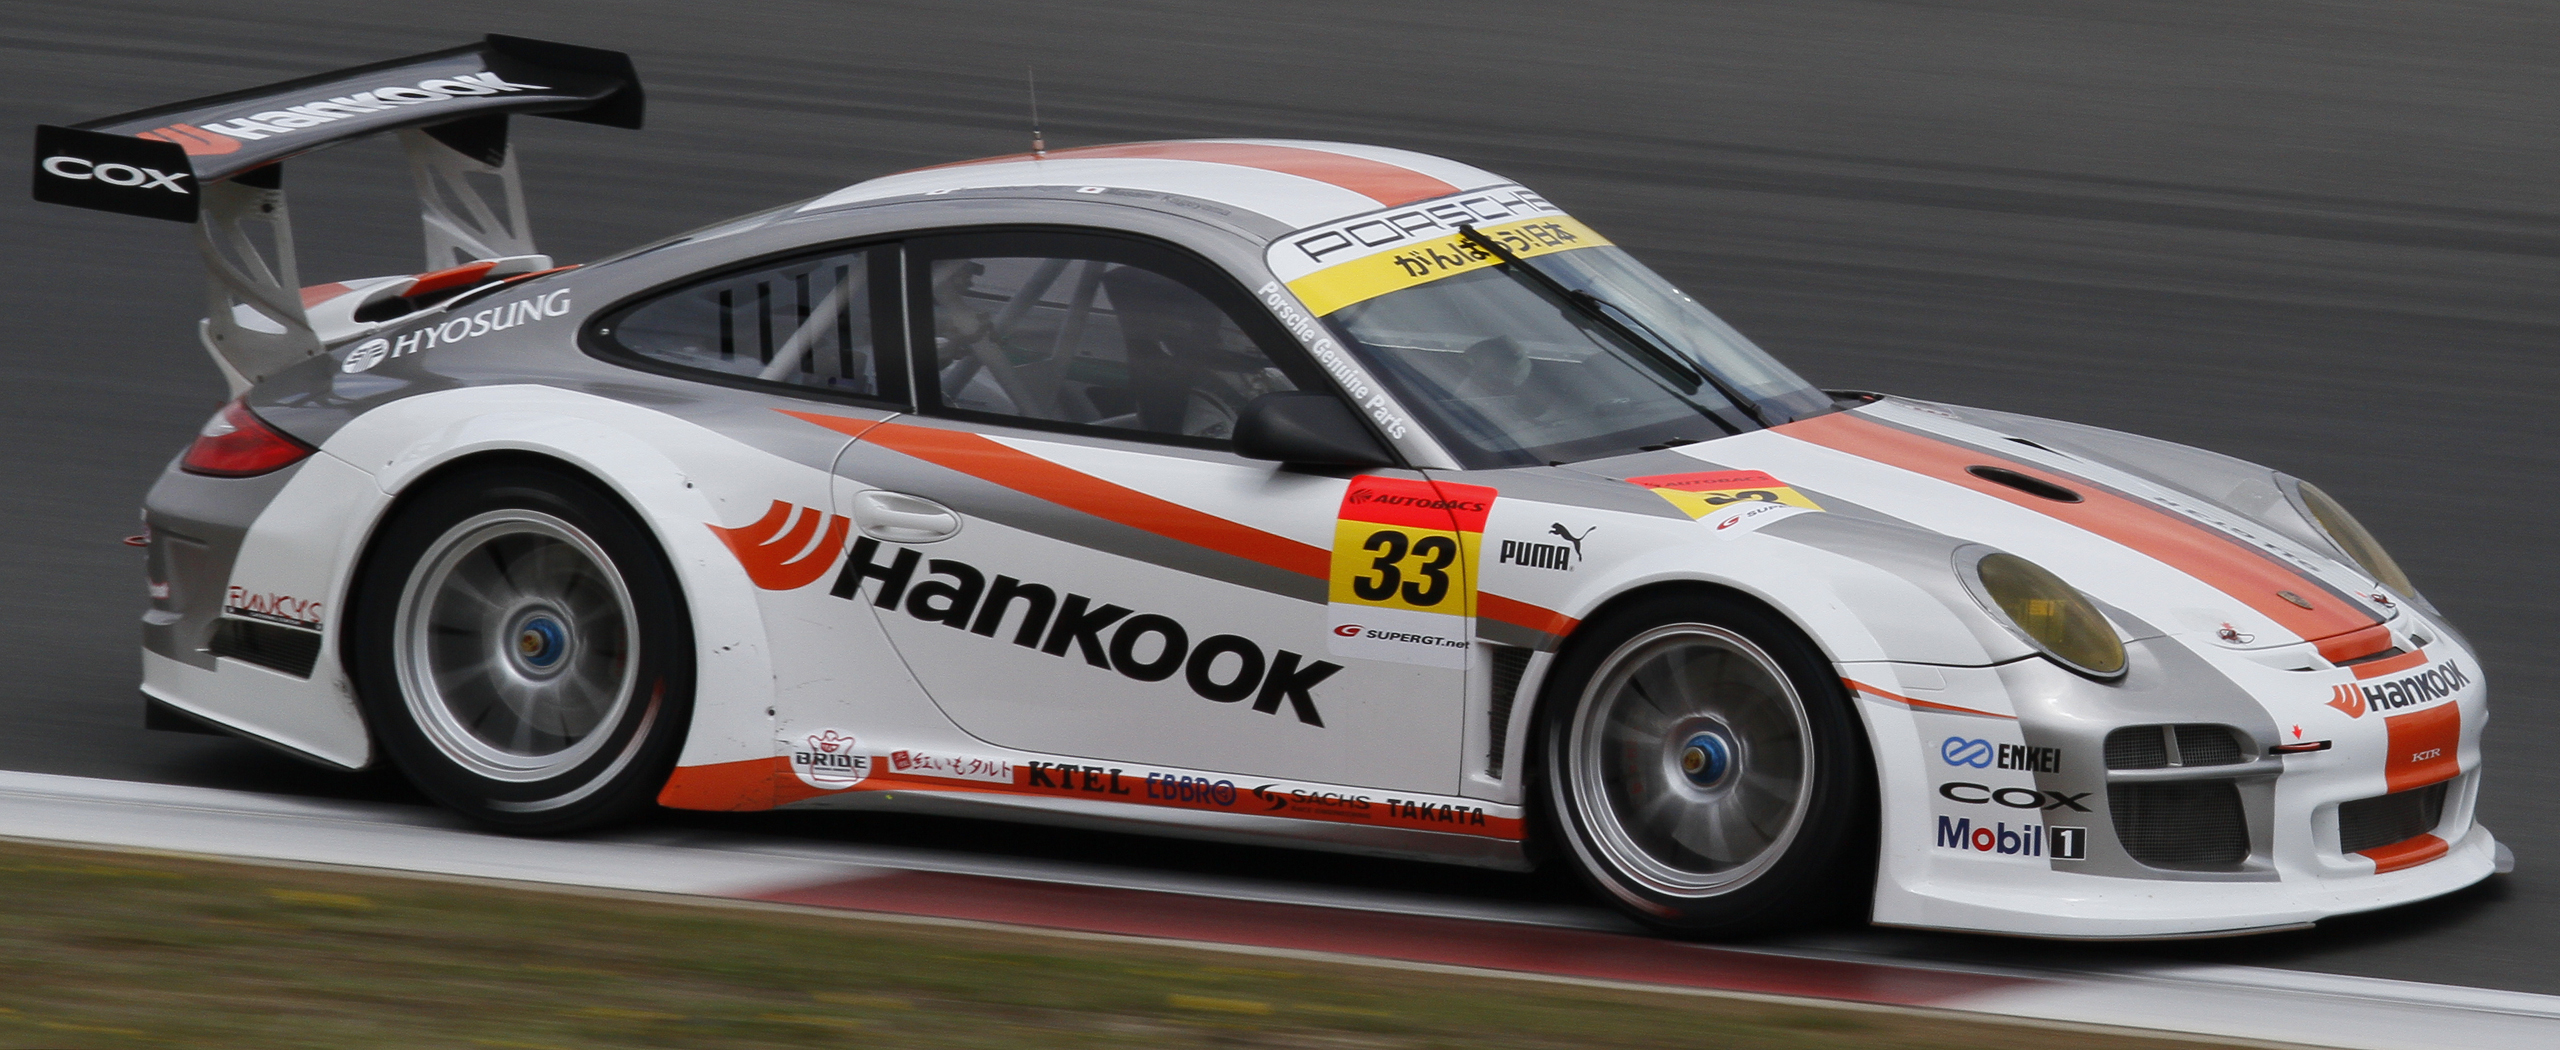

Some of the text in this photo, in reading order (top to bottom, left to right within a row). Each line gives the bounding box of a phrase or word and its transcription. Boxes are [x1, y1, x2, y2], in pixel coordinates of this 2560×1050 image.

[42, 156, 190, 194] COX
[1293, 189, 1560, 263] PORSCHE
[390, 288, 571, 358] HYOSUNG
[1258, 281, 1406, 439] Porsche Genuine Parts
[1373, 494, 1485, 512] AUTOBACS
[1353, 530, 1457, 607] 33
[1500, 539, 1570, 571] PUMA
[1366, 629, 1471, 650] SUPERGT.net
[795, 751, 867, 769] BRIDE
[912, 751, 1012, 779] 紅いもタルト
[1997, 743, 2061, 774] ENKEI
[1028, 761, 1130, 795] KTEL
[1290, 788, 1371, 811] SACHS
[1387, 798, 1486, 827] TAKATA
[1938, 782, 2094, 813] COX
[1937, 815, 2042, 857] Mobil
